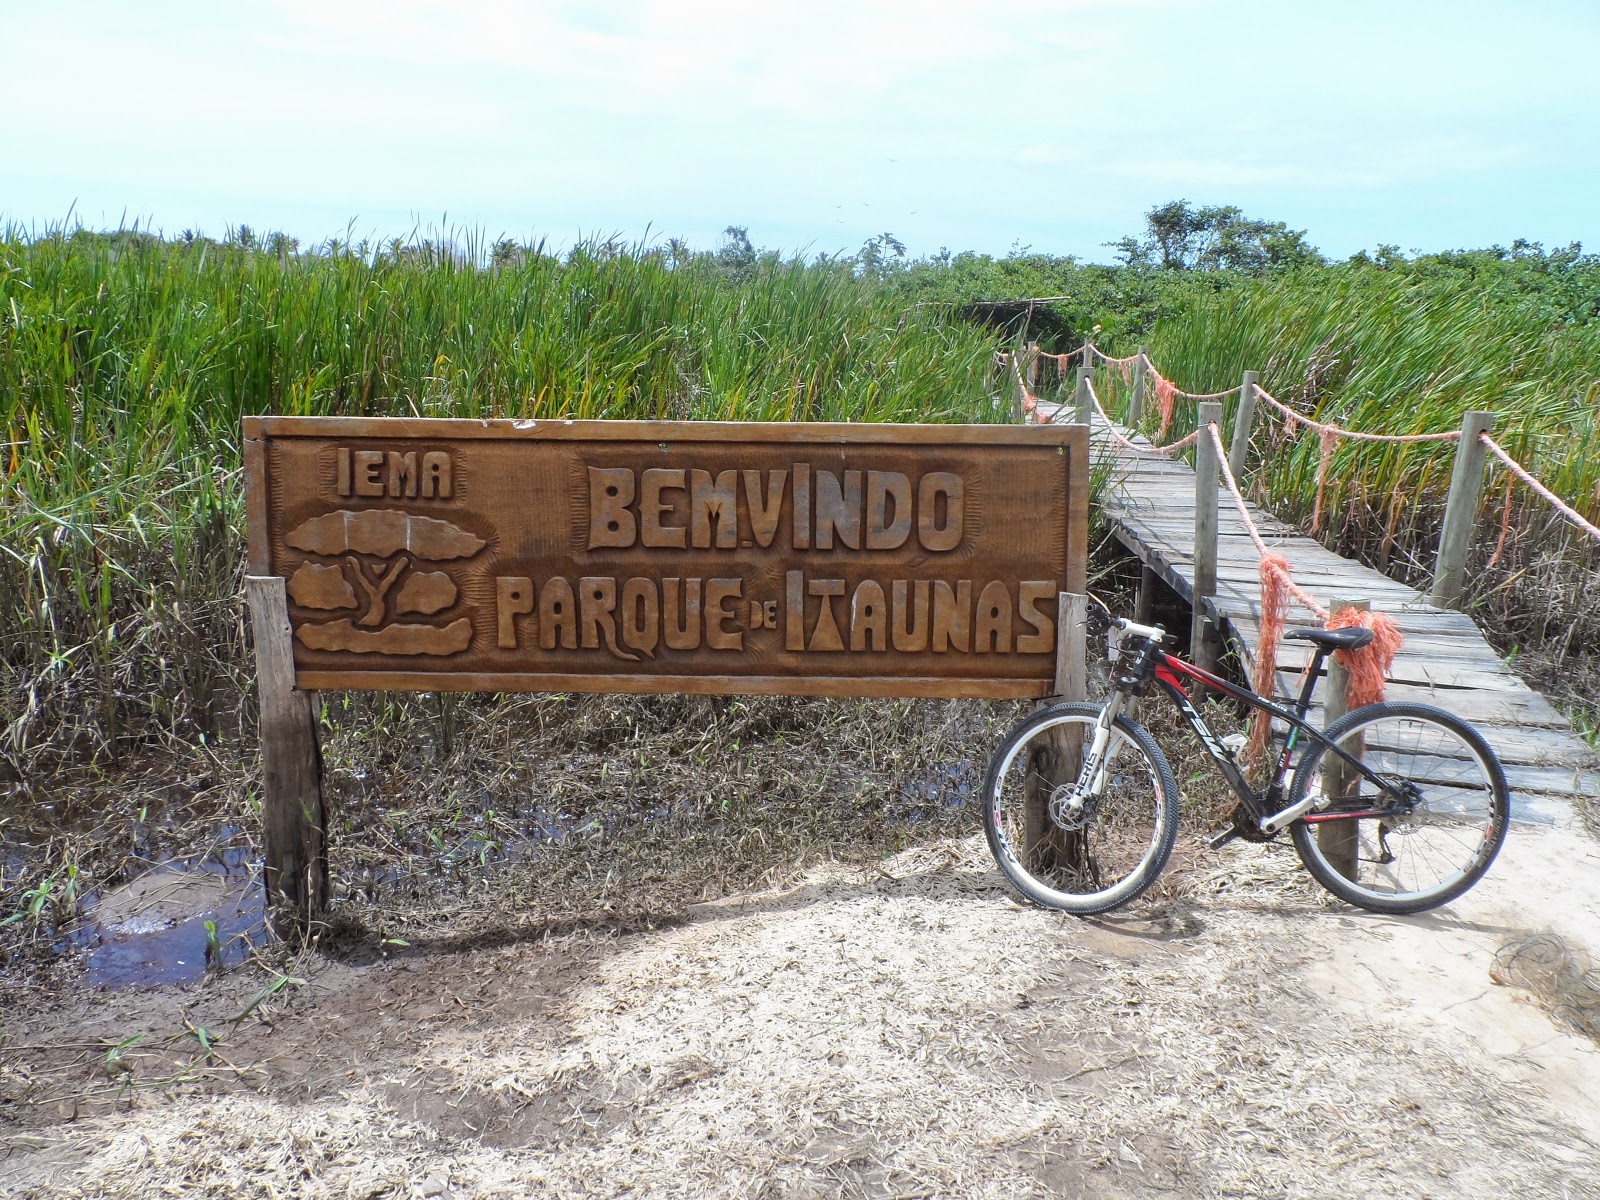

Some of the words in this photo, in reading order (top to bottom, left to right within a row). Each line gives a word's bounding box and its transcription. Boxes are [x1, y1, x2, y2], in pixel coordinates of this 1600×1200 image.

[337, 447, 453, 498] IEMA
[496, 576, 743, 661] PARQUE
[750, 600, 777, 630] DE
[786, 569, 1057, 654] ITAUNAS
[1182, 699, 1231, 765] TSW
